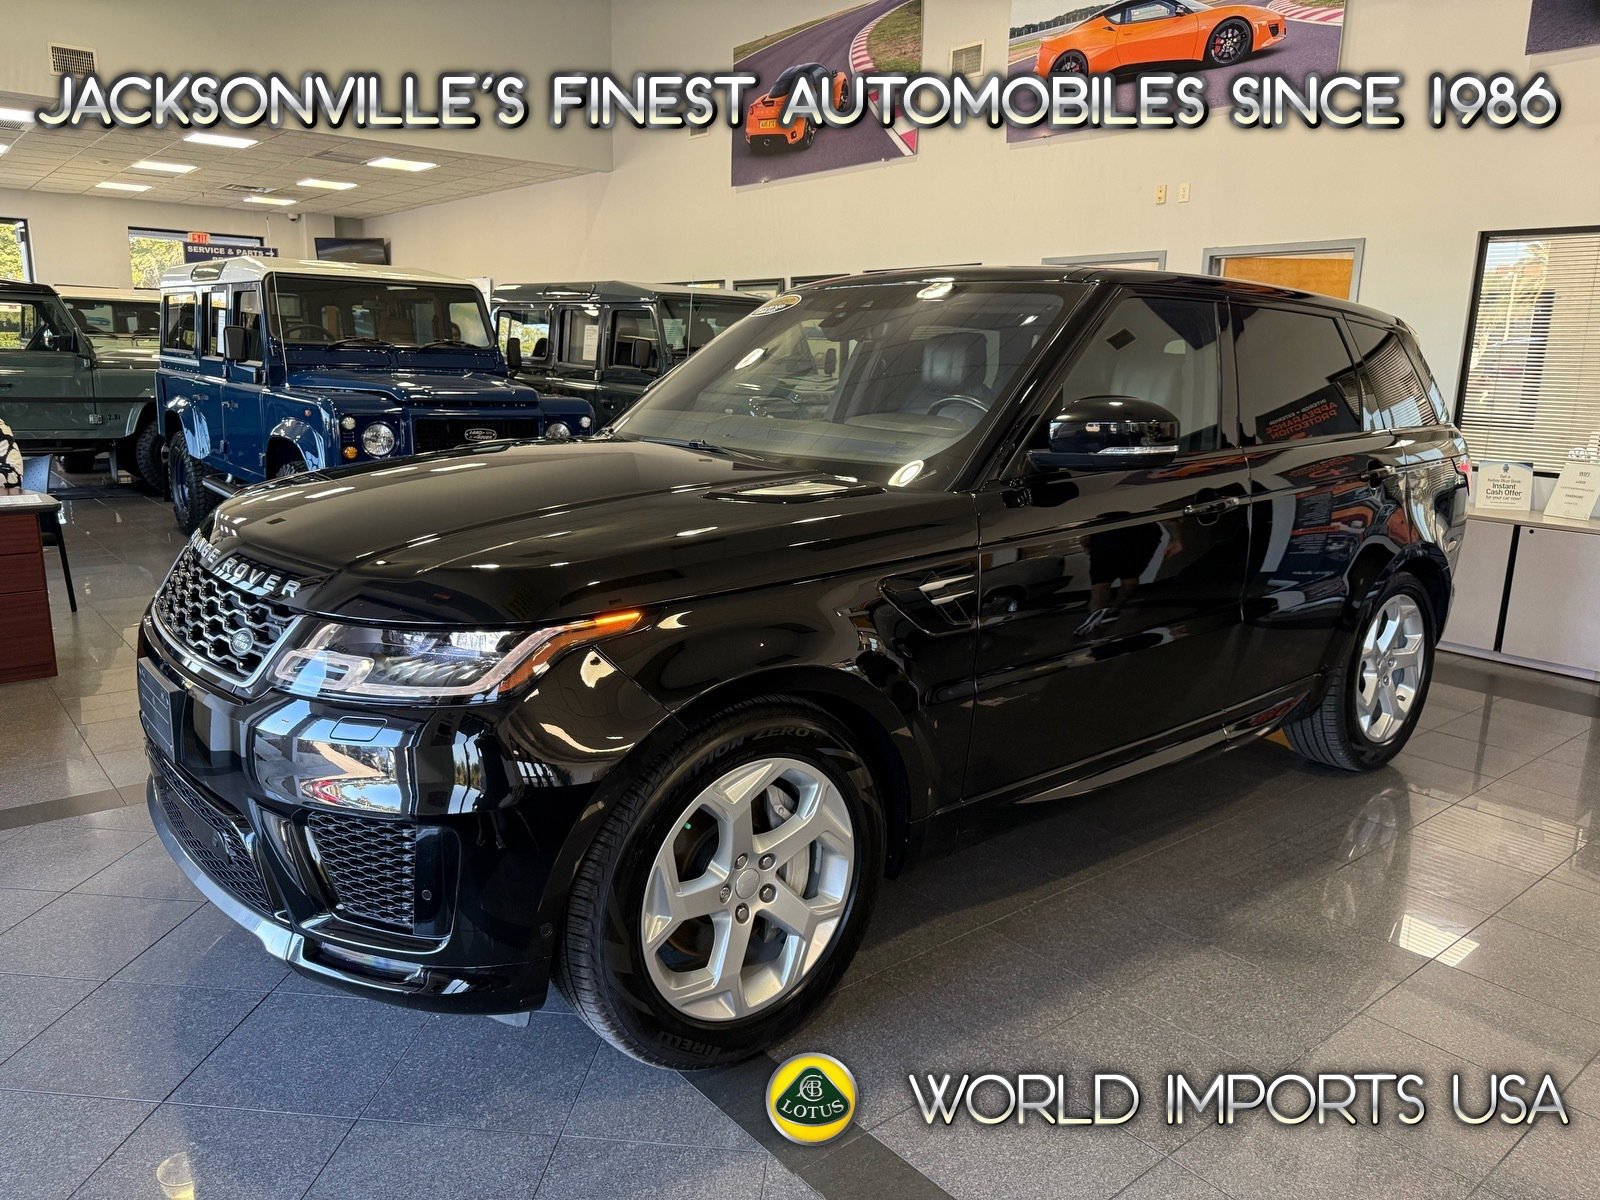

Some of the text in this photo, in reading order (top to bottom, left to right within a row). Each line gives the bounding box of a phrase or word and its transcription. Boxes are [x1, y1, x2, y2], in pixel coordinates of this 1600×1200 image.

[187, 245, 225, 255] SERVICE
[236, 249, 263, 257] PARTS
[1492, 482, 1516, 490] Instant
[1504, 489, 1523, 497] Offer
[222, 556, 303, 598] ROVER
[751, 726, 811, 742] ZERO
